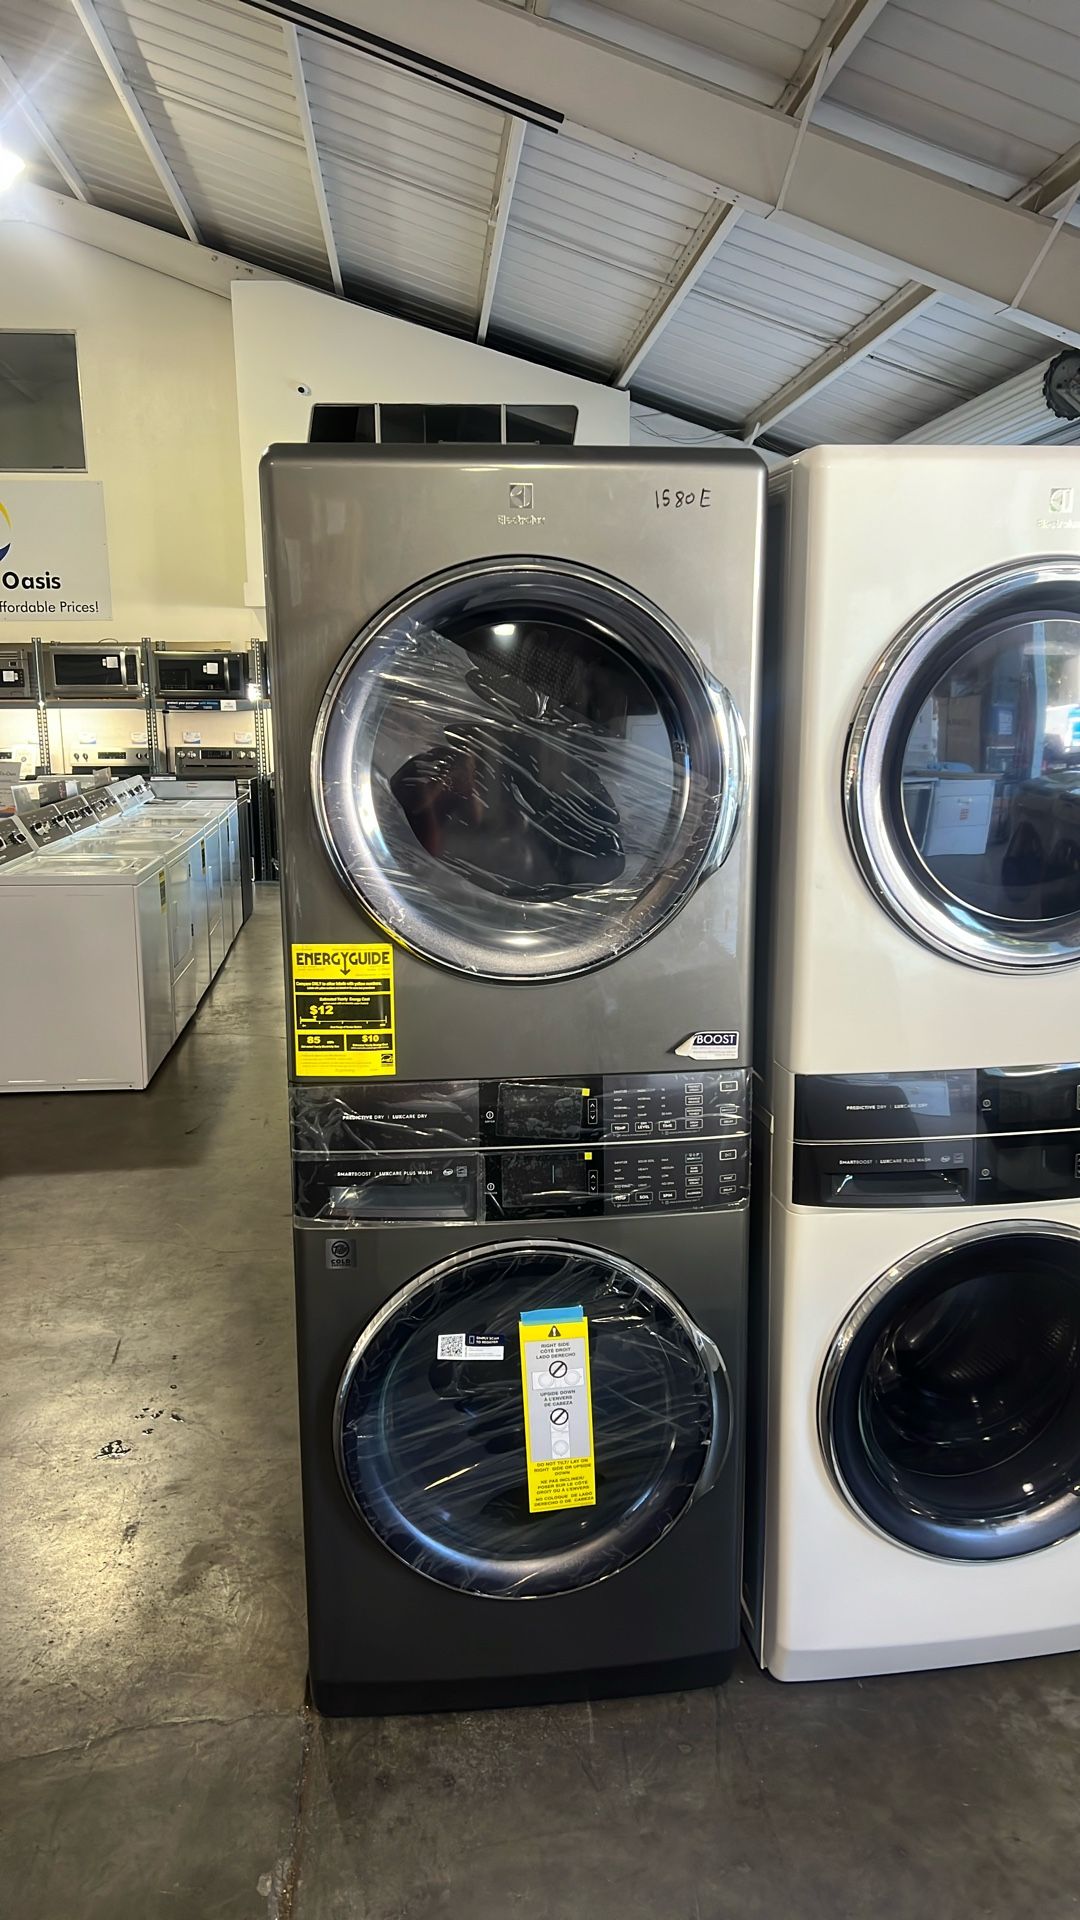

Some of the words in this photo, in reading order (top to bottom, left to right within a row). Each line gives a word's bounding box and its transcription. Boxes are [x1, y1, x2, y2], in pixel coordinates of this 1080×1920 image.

[654, 487, 712, 509] 1580E
[2, 571, 61, 589] Oasis
[60, 600, 99, 613] Prices!
[309, 1005, 334, 1015] $12
[306, 1036, 321, 1044] 85
[361, 1034, 380, 1043] $10
[696, 1034, 736, 1044] BOOST
